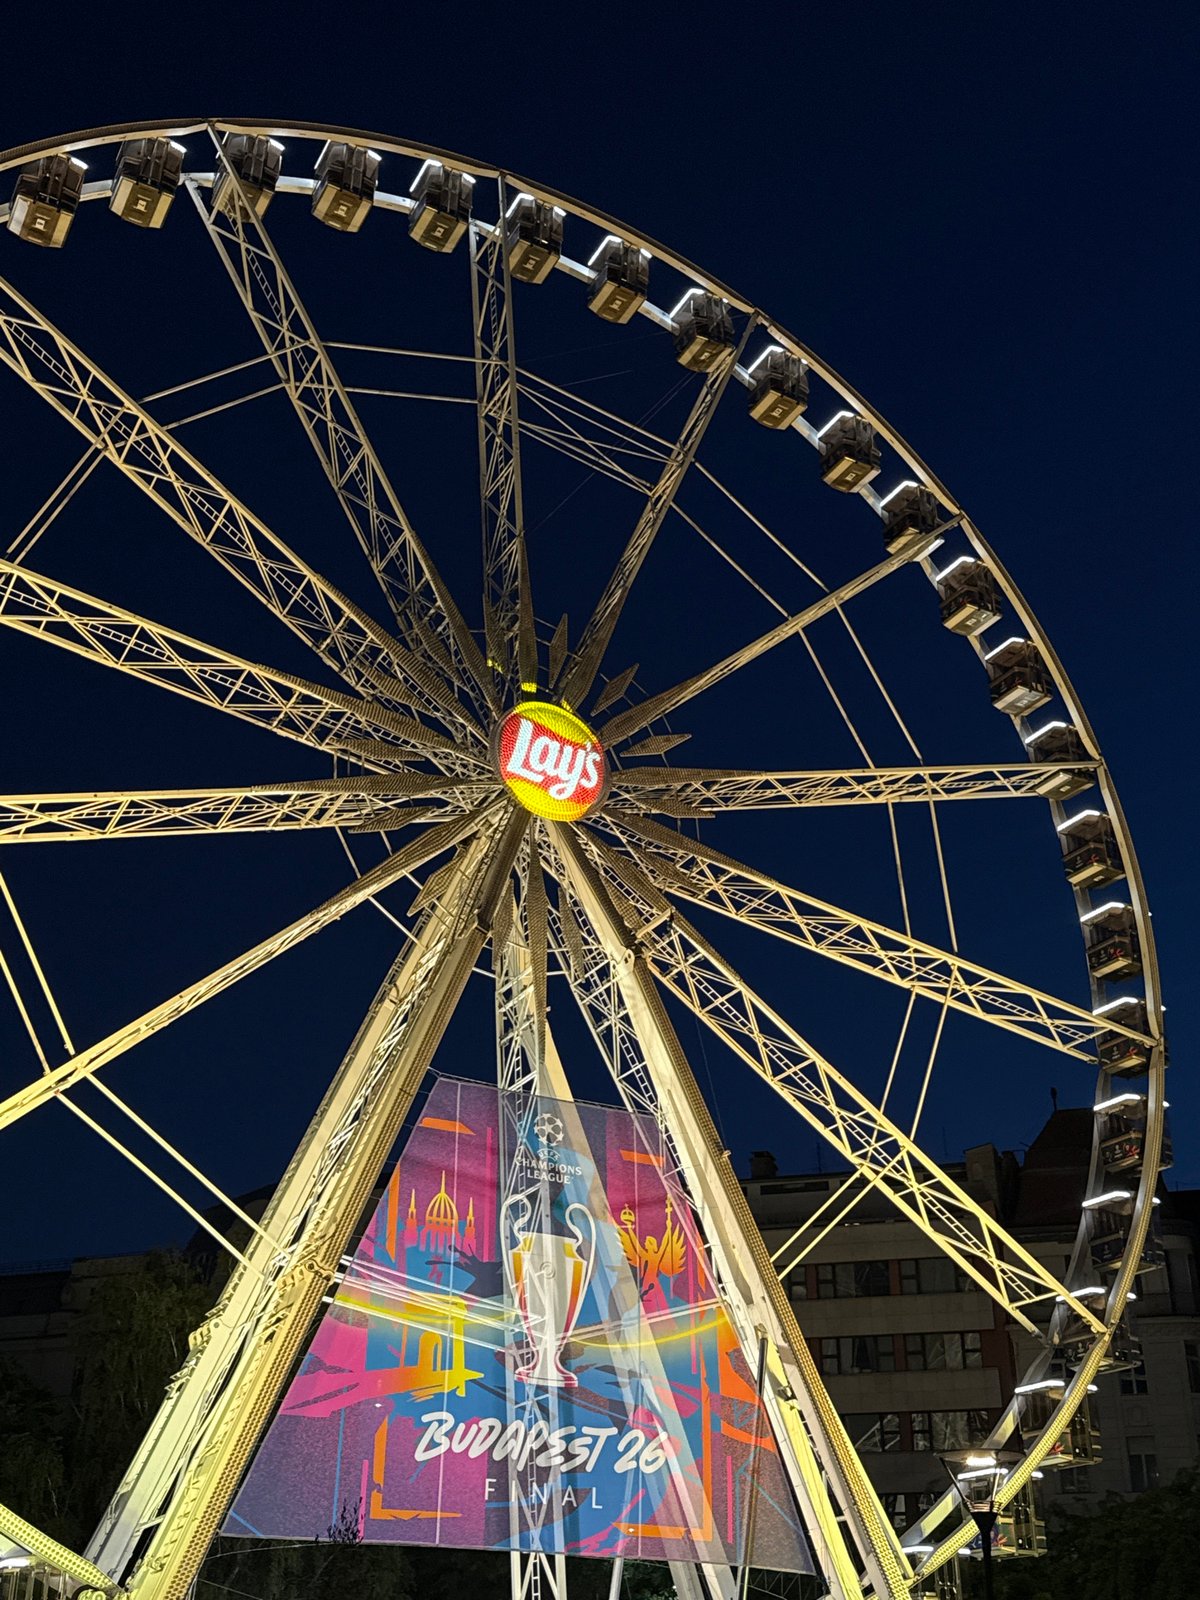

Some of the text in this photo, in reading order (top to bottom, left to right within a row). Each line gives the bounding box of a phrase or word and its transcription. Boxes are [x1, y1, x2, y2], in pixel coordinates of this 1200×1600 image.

[506, 718, 601, 800] Lay's
[527, 1169, 572, 1184] LEAGUE
[414, 1411, 668, 1474] BUDAPEST 26
[485, 1478, 603, 1509] FINAL
